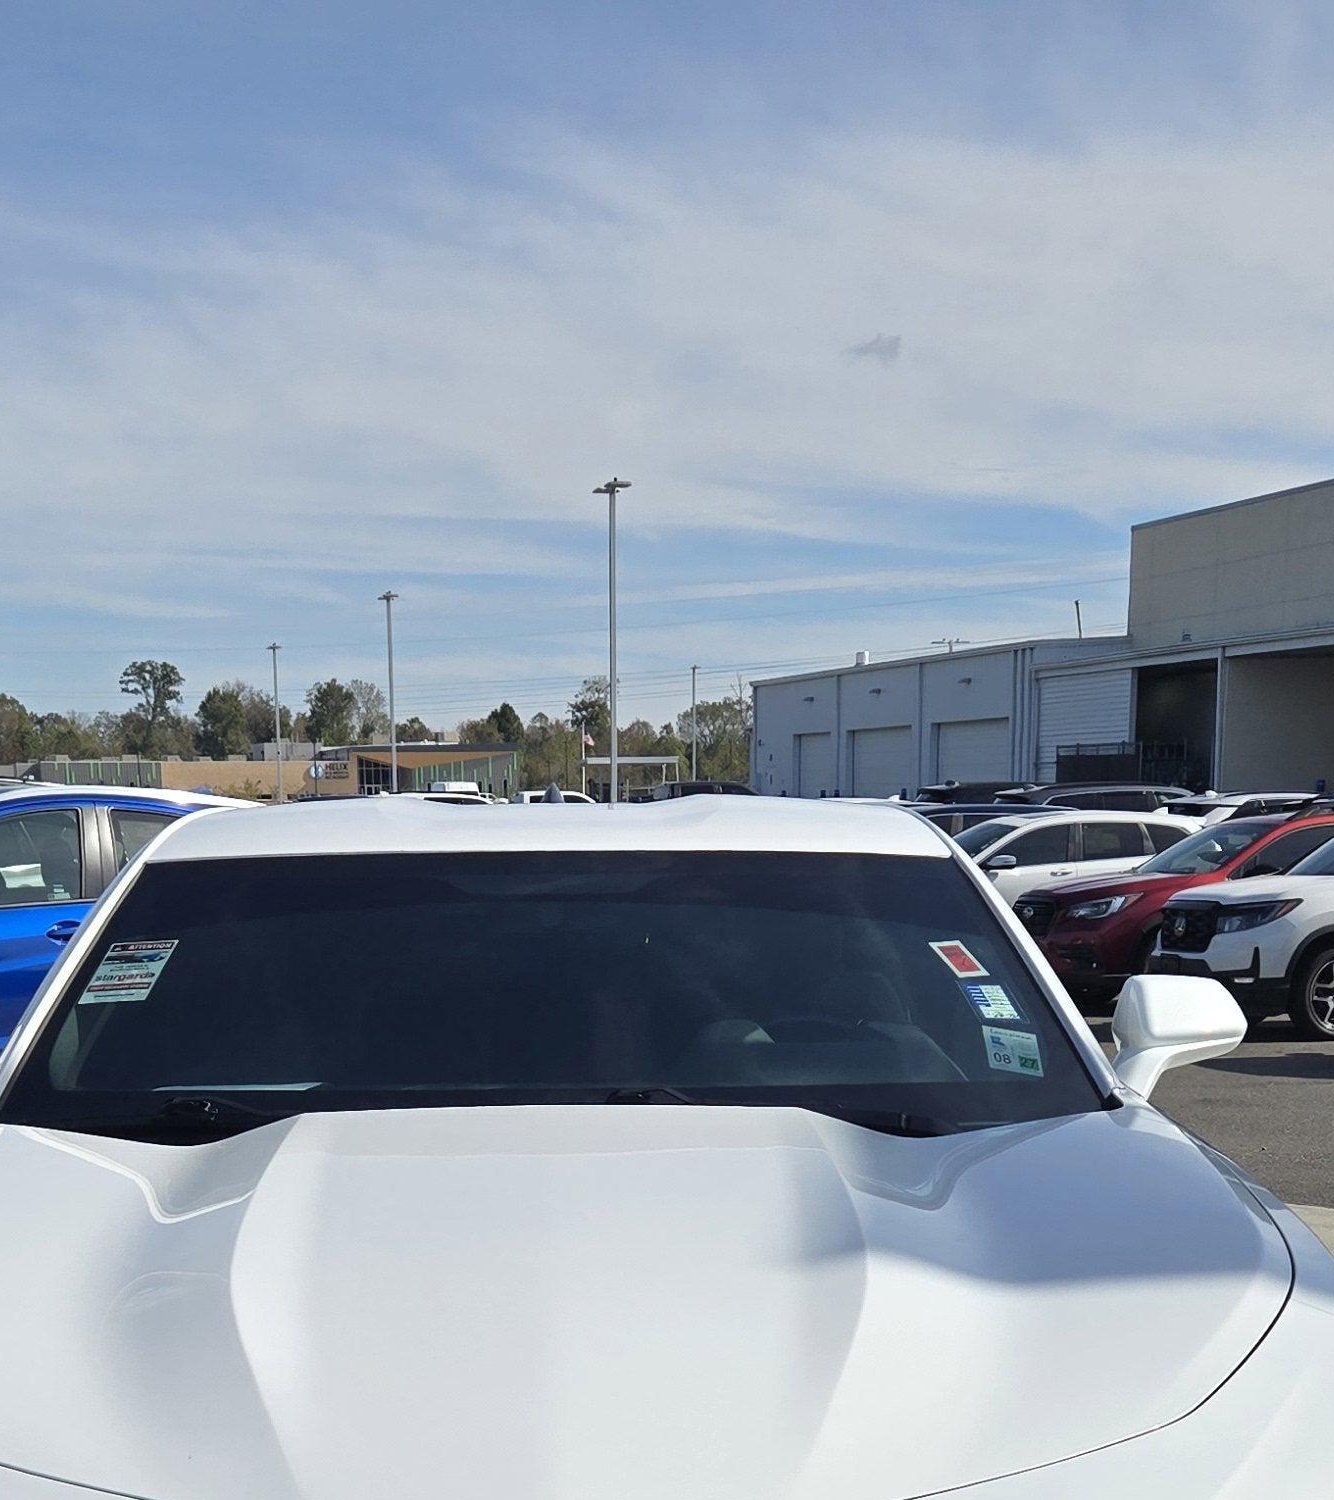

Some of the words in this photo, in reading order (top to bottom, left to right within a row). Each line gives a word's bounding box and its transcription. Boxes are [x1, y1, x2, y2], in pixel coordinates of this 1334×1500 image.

[128, 942, 173, 950] ATTENTION
[993, 1052, 1012, 1064] 08
[1021, 1056, 1036, 1069] 27
